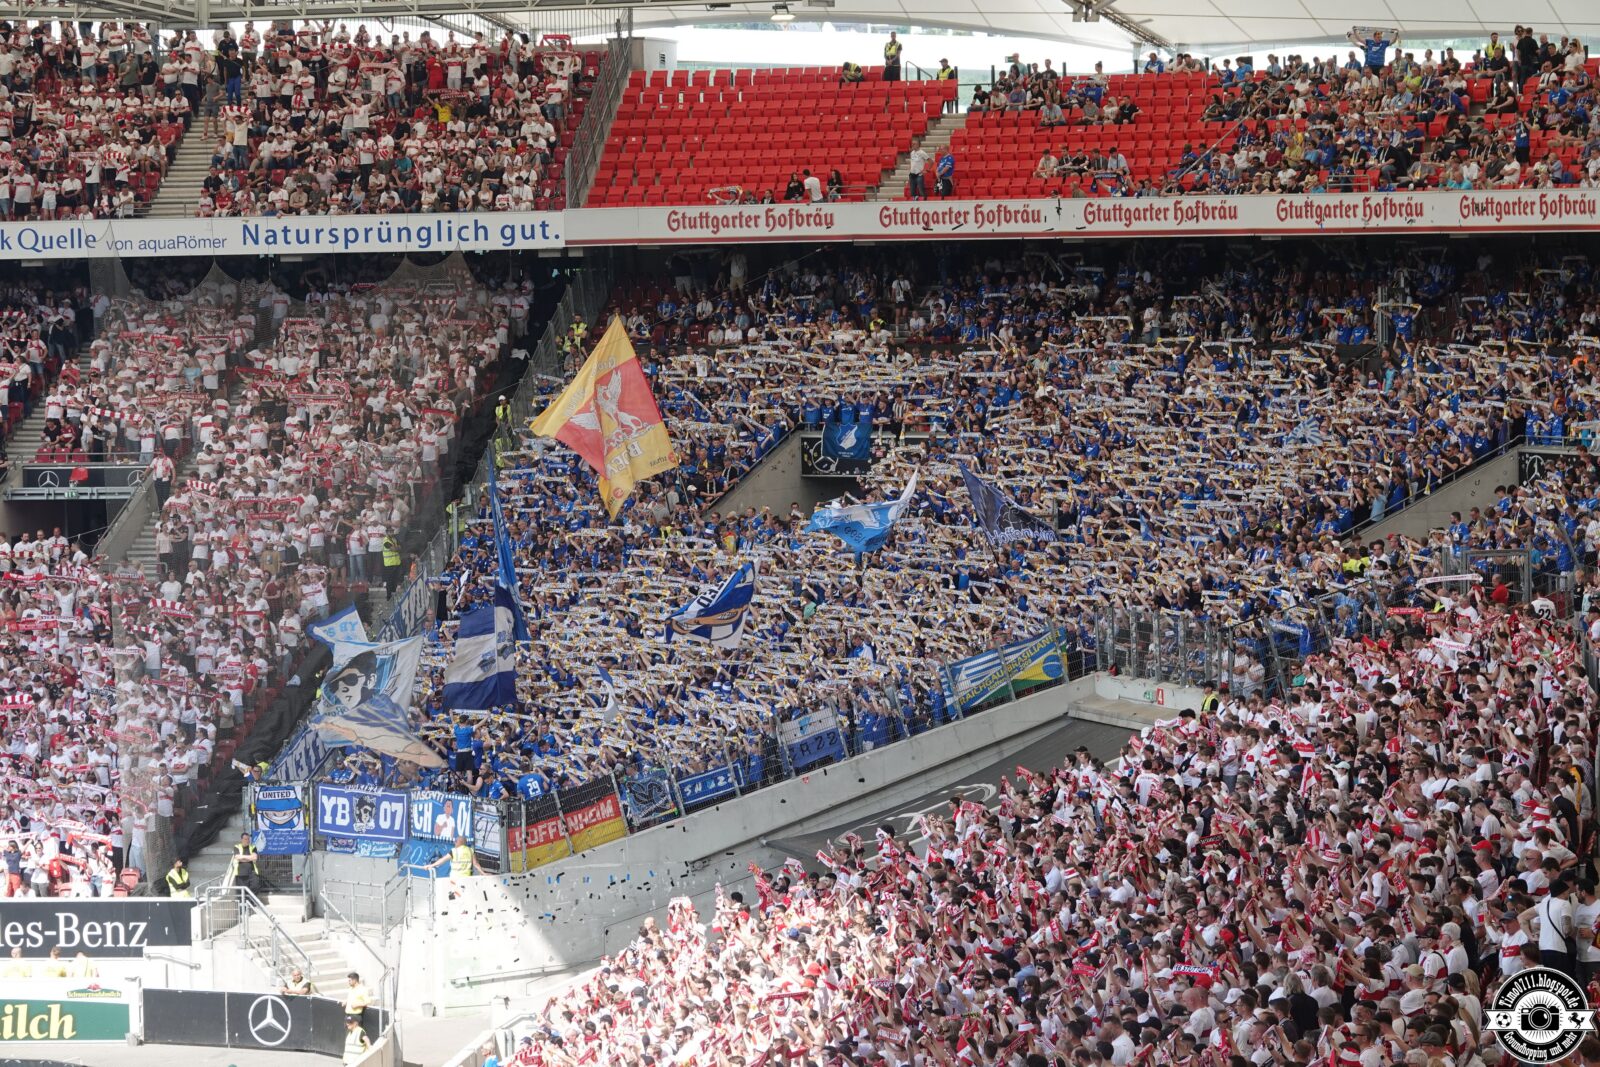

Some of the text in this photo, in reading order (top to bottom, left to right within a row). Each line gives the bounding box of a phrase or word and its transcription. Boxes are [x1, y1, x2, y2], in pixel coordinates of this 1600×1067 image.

[667, 207, 835, 235] Stuttgarter Hofbräu
[879, 203, 1042, 229] Stuttgarter Hofbräu
[1083, 199, 1239, 228] Stuttgarter Hofbräu
[1276, 195, 1425, 226] Stuttgarter Hofbräu
[1459, 192, 1597, 223] Stuttgarter Hofbräu
[17, 227, 98, 253] Quelle
[106, 239, 133, 251] von
[138, 234, 228, 253] aquaRömer
[242, 218, 490, 249] Natursprünglich
[500, 218, 561, 247] gut.
[1538, 608, 1552, 621] 22
[262, 791, 291, 799] UNITED
[526, 780, 542, 797] 29
[321, 795, 404, 831] YB 07
[412, 801, 433, 834] CH
[514, 799, 615, 849] HOFFENHEIM
[0, 912, 149, 949] es-Benz
[0, 1003, 77, 1041] ilch
